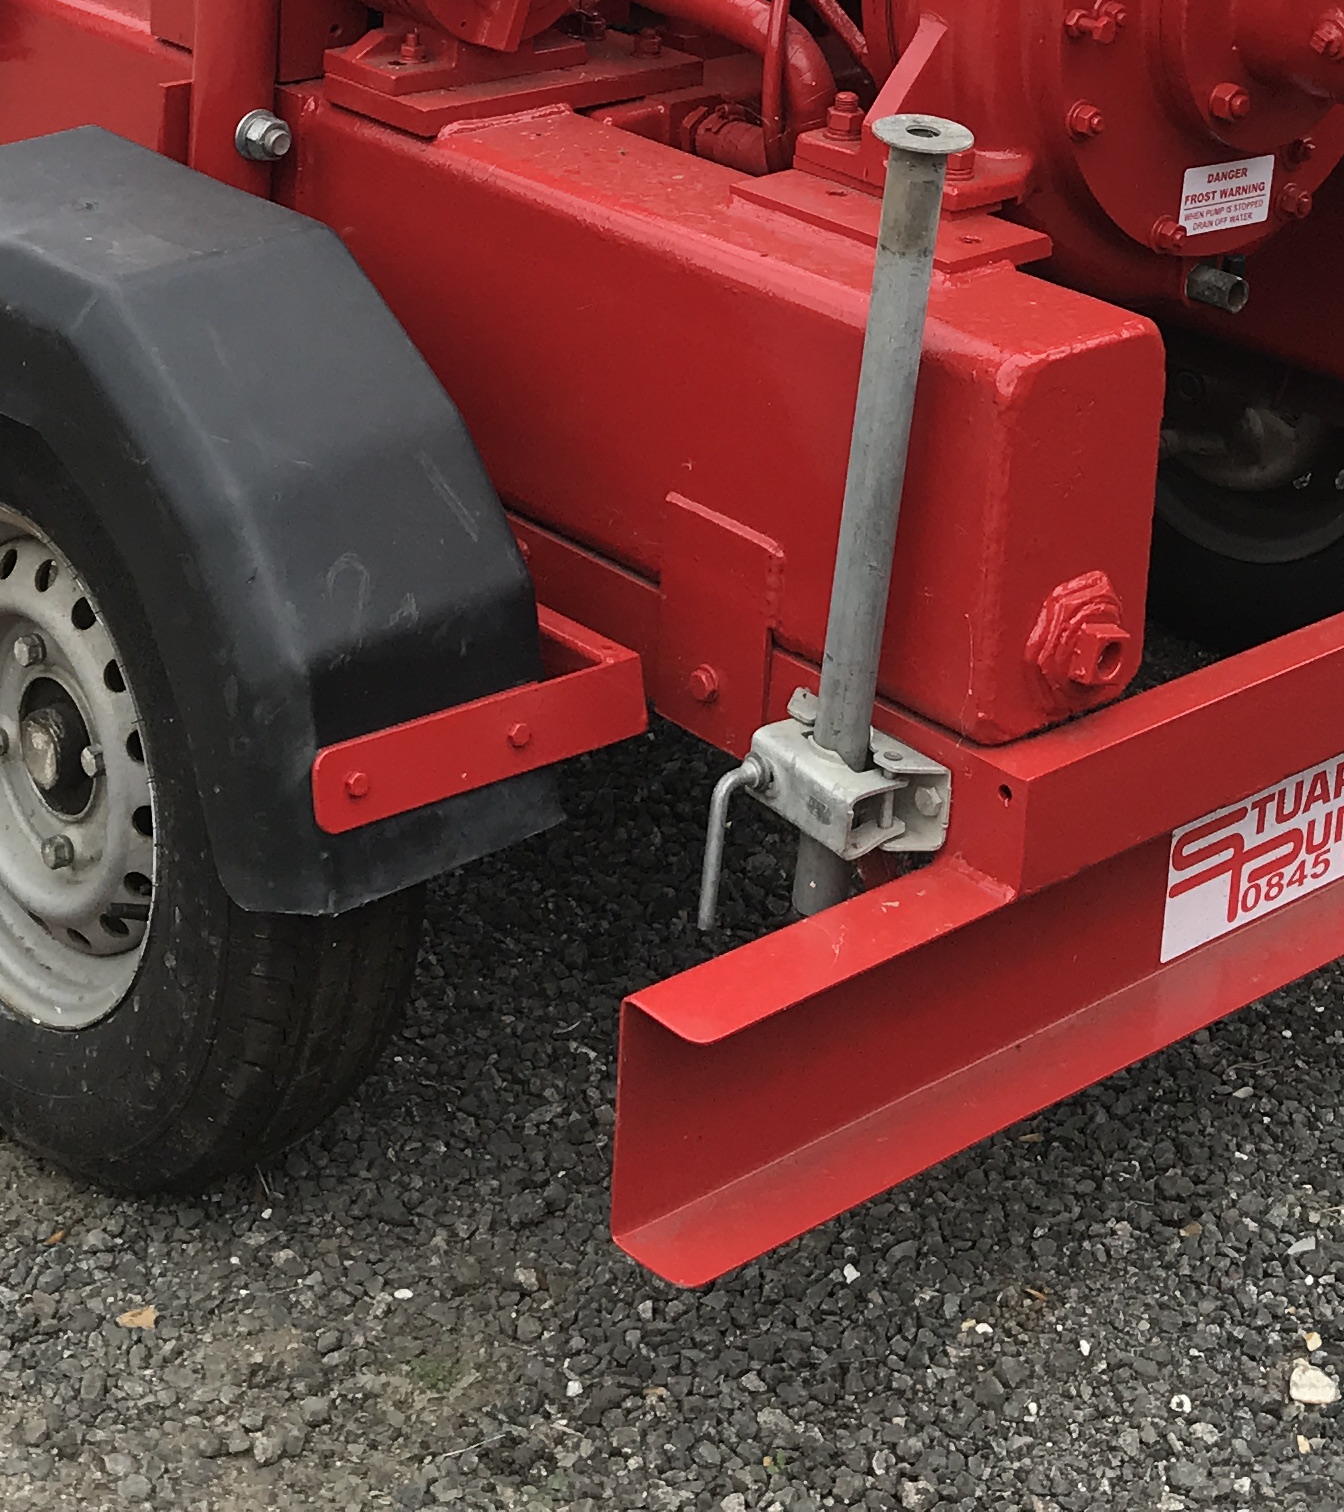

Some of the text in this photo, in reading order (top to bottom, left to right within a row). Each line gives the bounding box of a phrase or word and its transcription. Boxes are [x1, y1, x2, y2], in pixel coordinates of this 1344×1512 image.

[1207, 168, 1248, 183] DANGER
[1184, 182, 1265, 206] FROST WARNING
[1184, 199, 1263, 221] WHEN PUMP IS STOPPED
[1193, 212, 1252, 230] DRAIN OFF WATER
[1240, 848, 1331, 913] 0845
